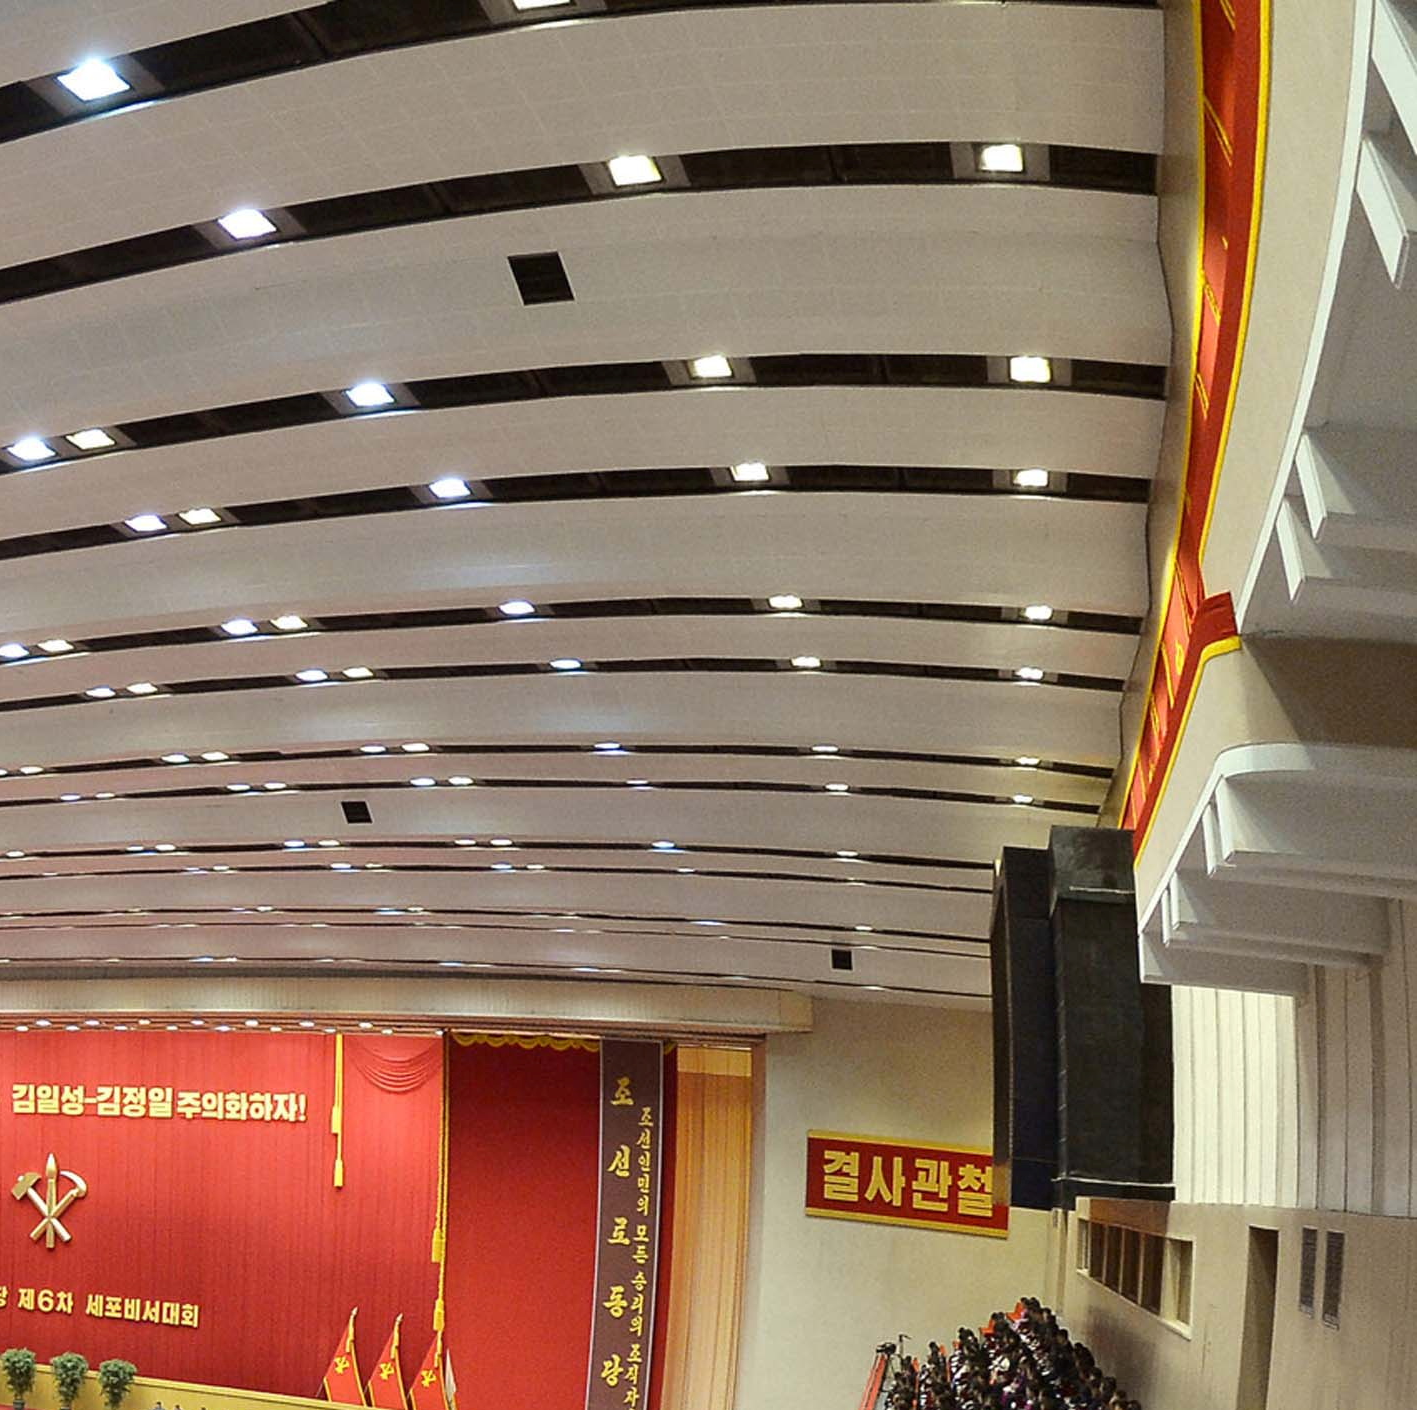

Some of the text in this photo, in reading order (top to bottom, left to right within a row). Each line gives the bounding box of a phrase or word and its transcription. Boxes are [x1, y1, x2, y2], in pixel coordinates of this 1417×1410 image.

[11, 1083, 307, 1122] 김일성-김정일주의화하자!
[636, 1106, 654, 1217] 조선인민의
[821, 1148, 994, 1219] 결사관철
[631, 1224, 650, 1265] 모든
[17, 1287, 74, 1314] 제6차
[629, 1273, 648, 1336] 승리의
